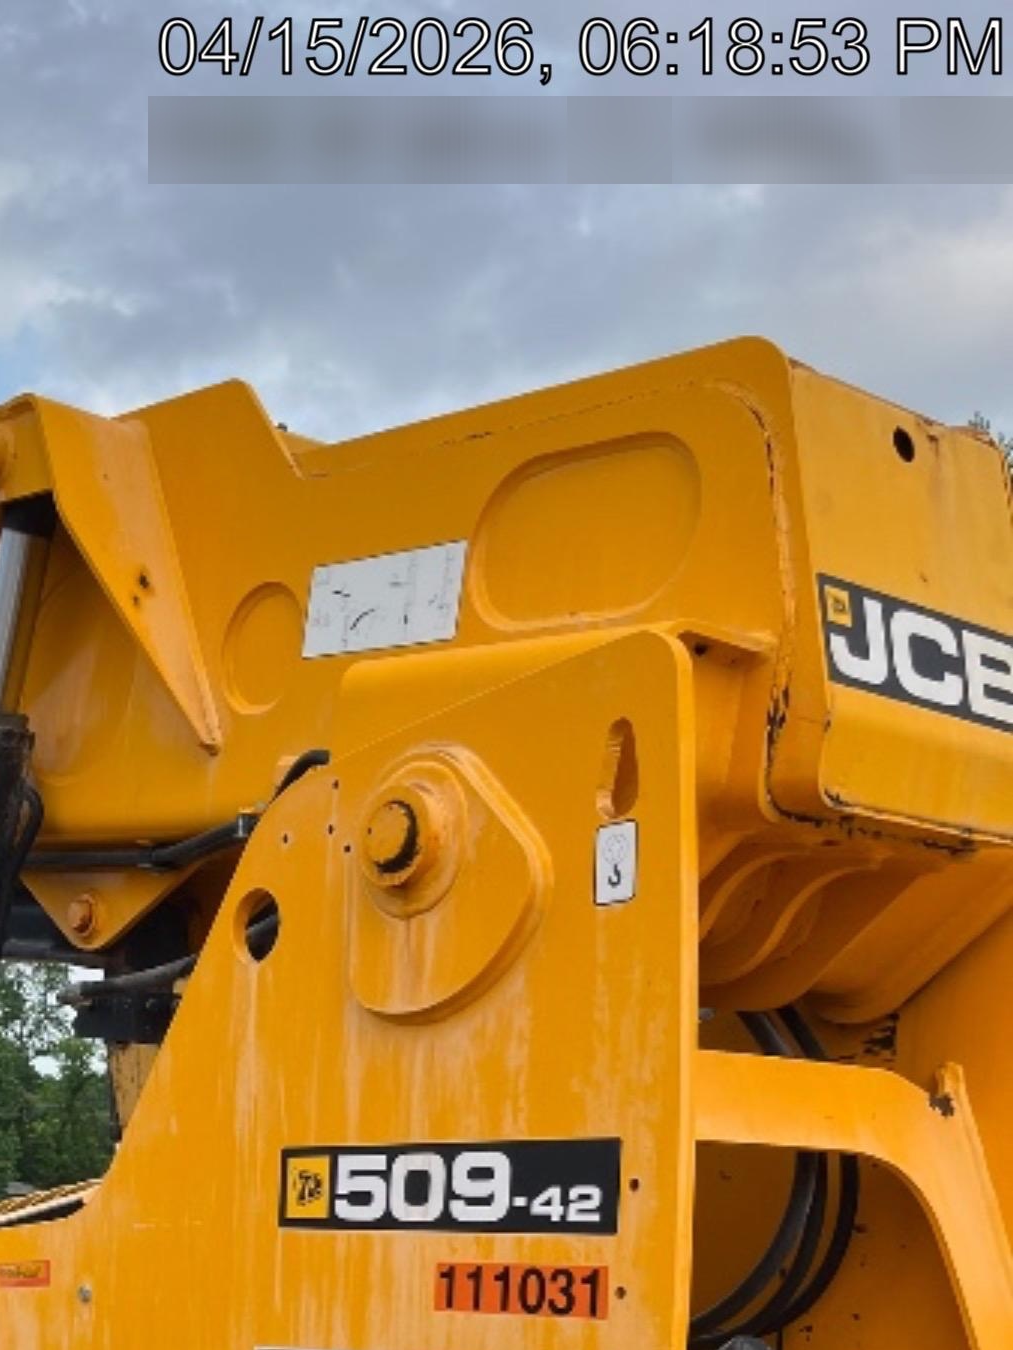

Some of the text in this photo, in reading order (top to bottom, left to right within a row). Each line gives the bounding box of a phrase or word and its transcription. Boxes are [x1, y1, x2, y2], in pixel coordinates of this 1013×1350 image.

[829, 596, 1013, 724] JCB
[334, 1151, 603, 1223] 509-42
[439, 1265, 600, 1317] 111031
